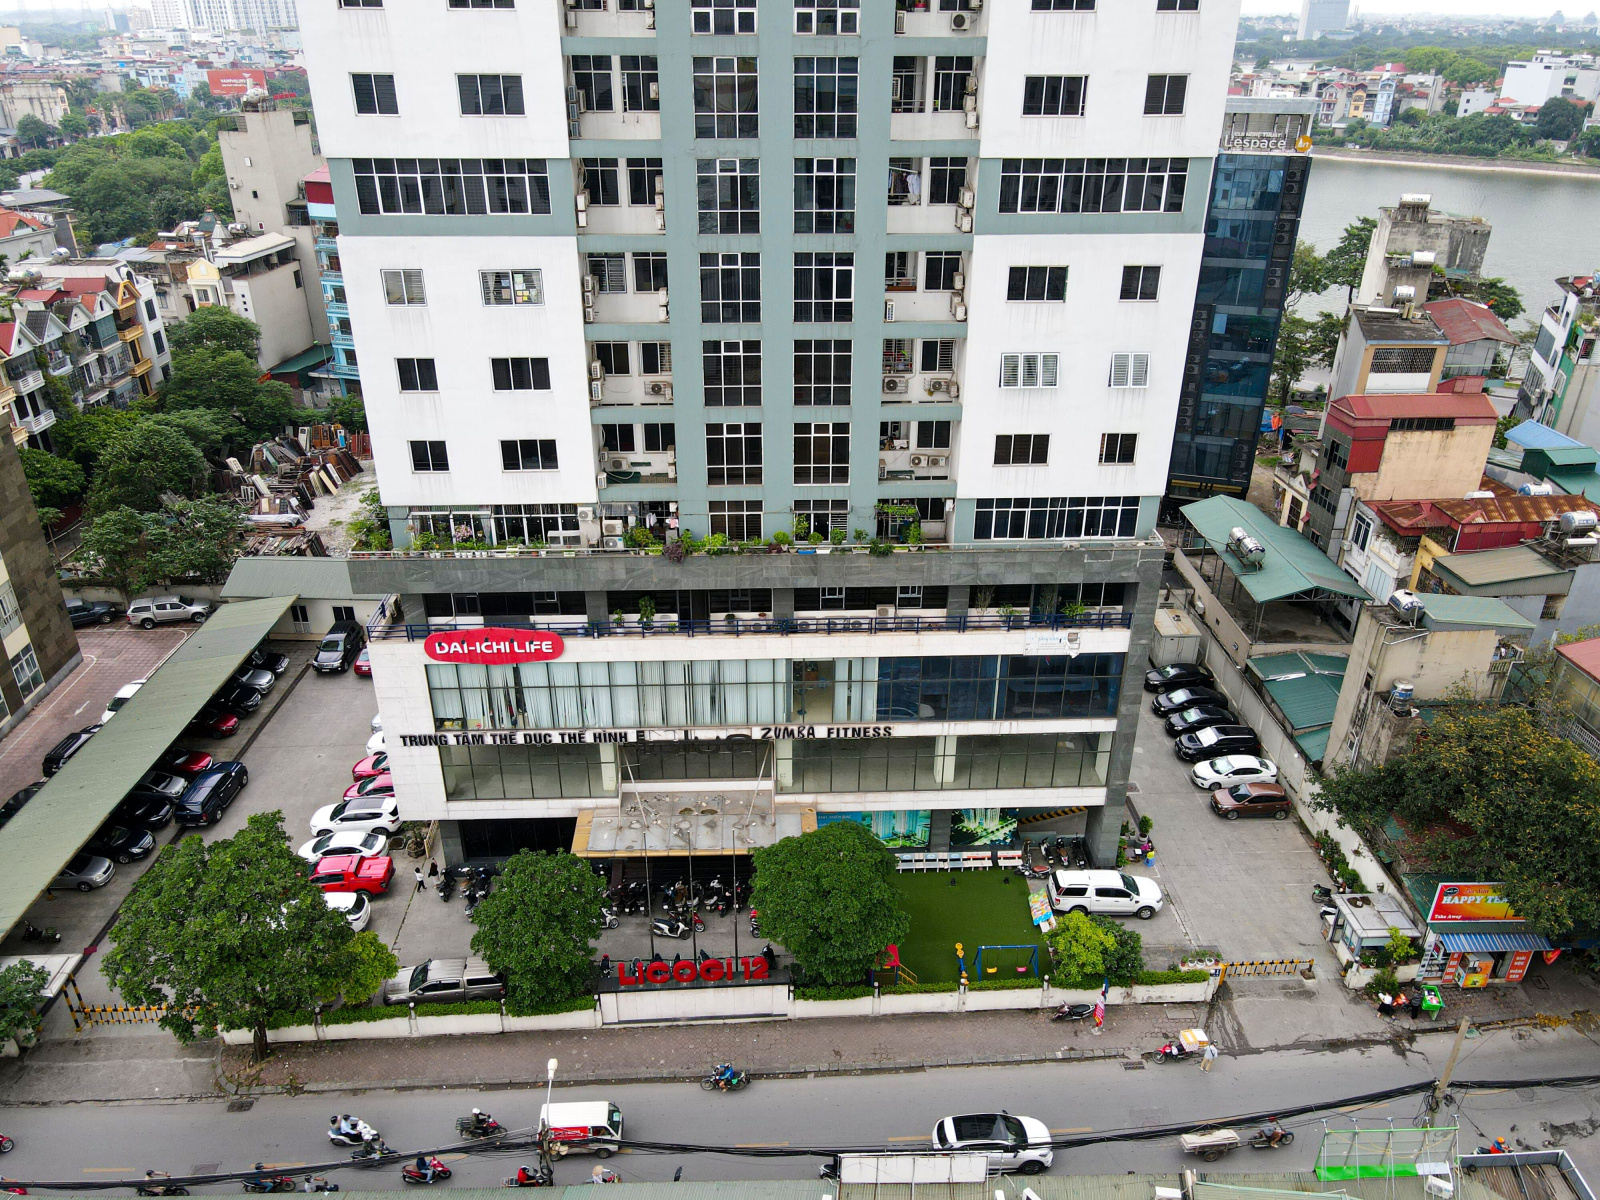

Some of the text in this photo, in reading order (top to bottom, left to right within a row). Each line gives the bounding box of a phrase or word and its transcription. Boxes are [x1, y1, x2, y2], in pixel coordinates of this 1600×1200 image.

[435, 641, 553, 654] DAI-ICHI LIFE
[400, 734, 448, 746] TRUNG
[454, 731, 485, 746] TÂM
[524, 732, 552, 747] DỤC
[593, 731, 629, 744] HÌNH
[760, 725, 893, 740] ZUMBA FITNESS
[1442, 895, 1483, 904] HAPPY
[618, 956, 769, 986] LICOGI 12
